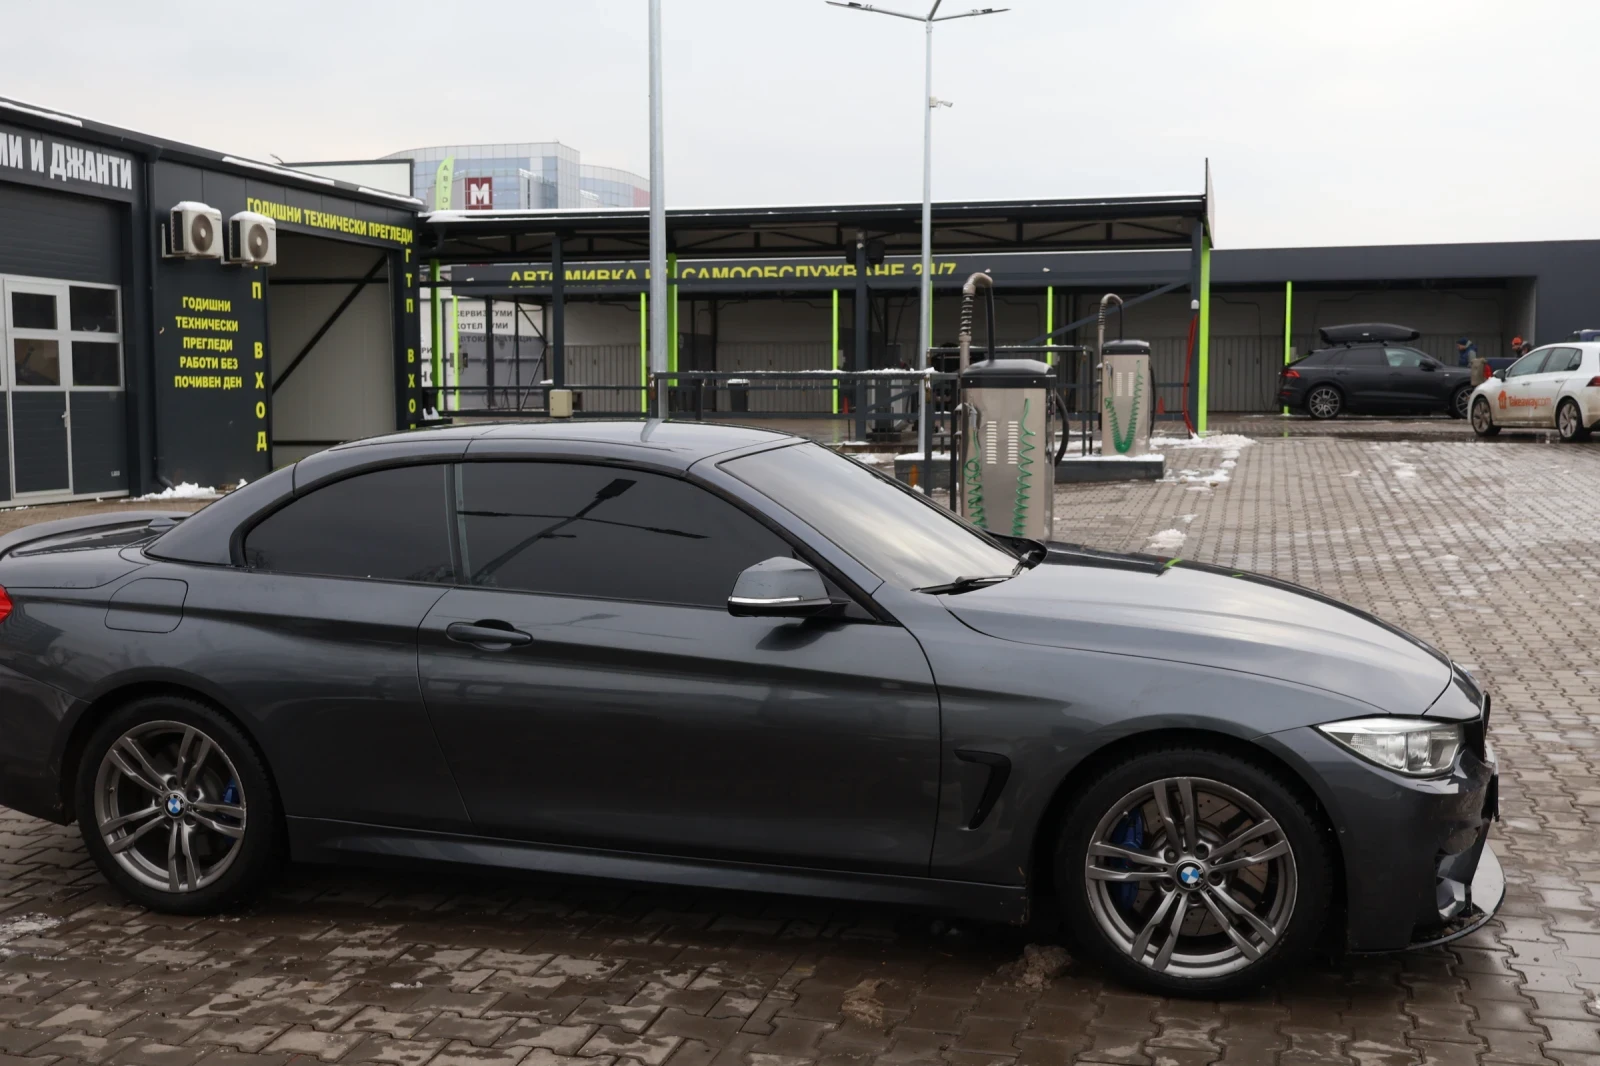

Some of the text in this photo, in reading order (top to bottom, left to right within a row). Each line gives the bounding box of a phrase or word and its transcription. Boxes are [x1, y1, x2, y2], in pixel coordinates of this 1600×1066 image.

[30, 138, 44, 173] И
[50, 142, 132, 190] ДЖАНТИ
[247, 197, 413, 245] ГОДИШНИ ТЕХНИЧЕСКИ ПРЕГЛЕДИ
[182, 296, 231, 312] ГОДИШНИ
[175, 316, 239, 332] ТЕХНИЧЕСКИ
[183, 337, 233, 353] ПРЕГЛЕДИ
[180, 356, 238, 370] РАБОТИ БЕЗ
[174, 376, 242, 390] ПОЧИВЕН ДЕН
[254, 341, 267, 452] ВХОД
